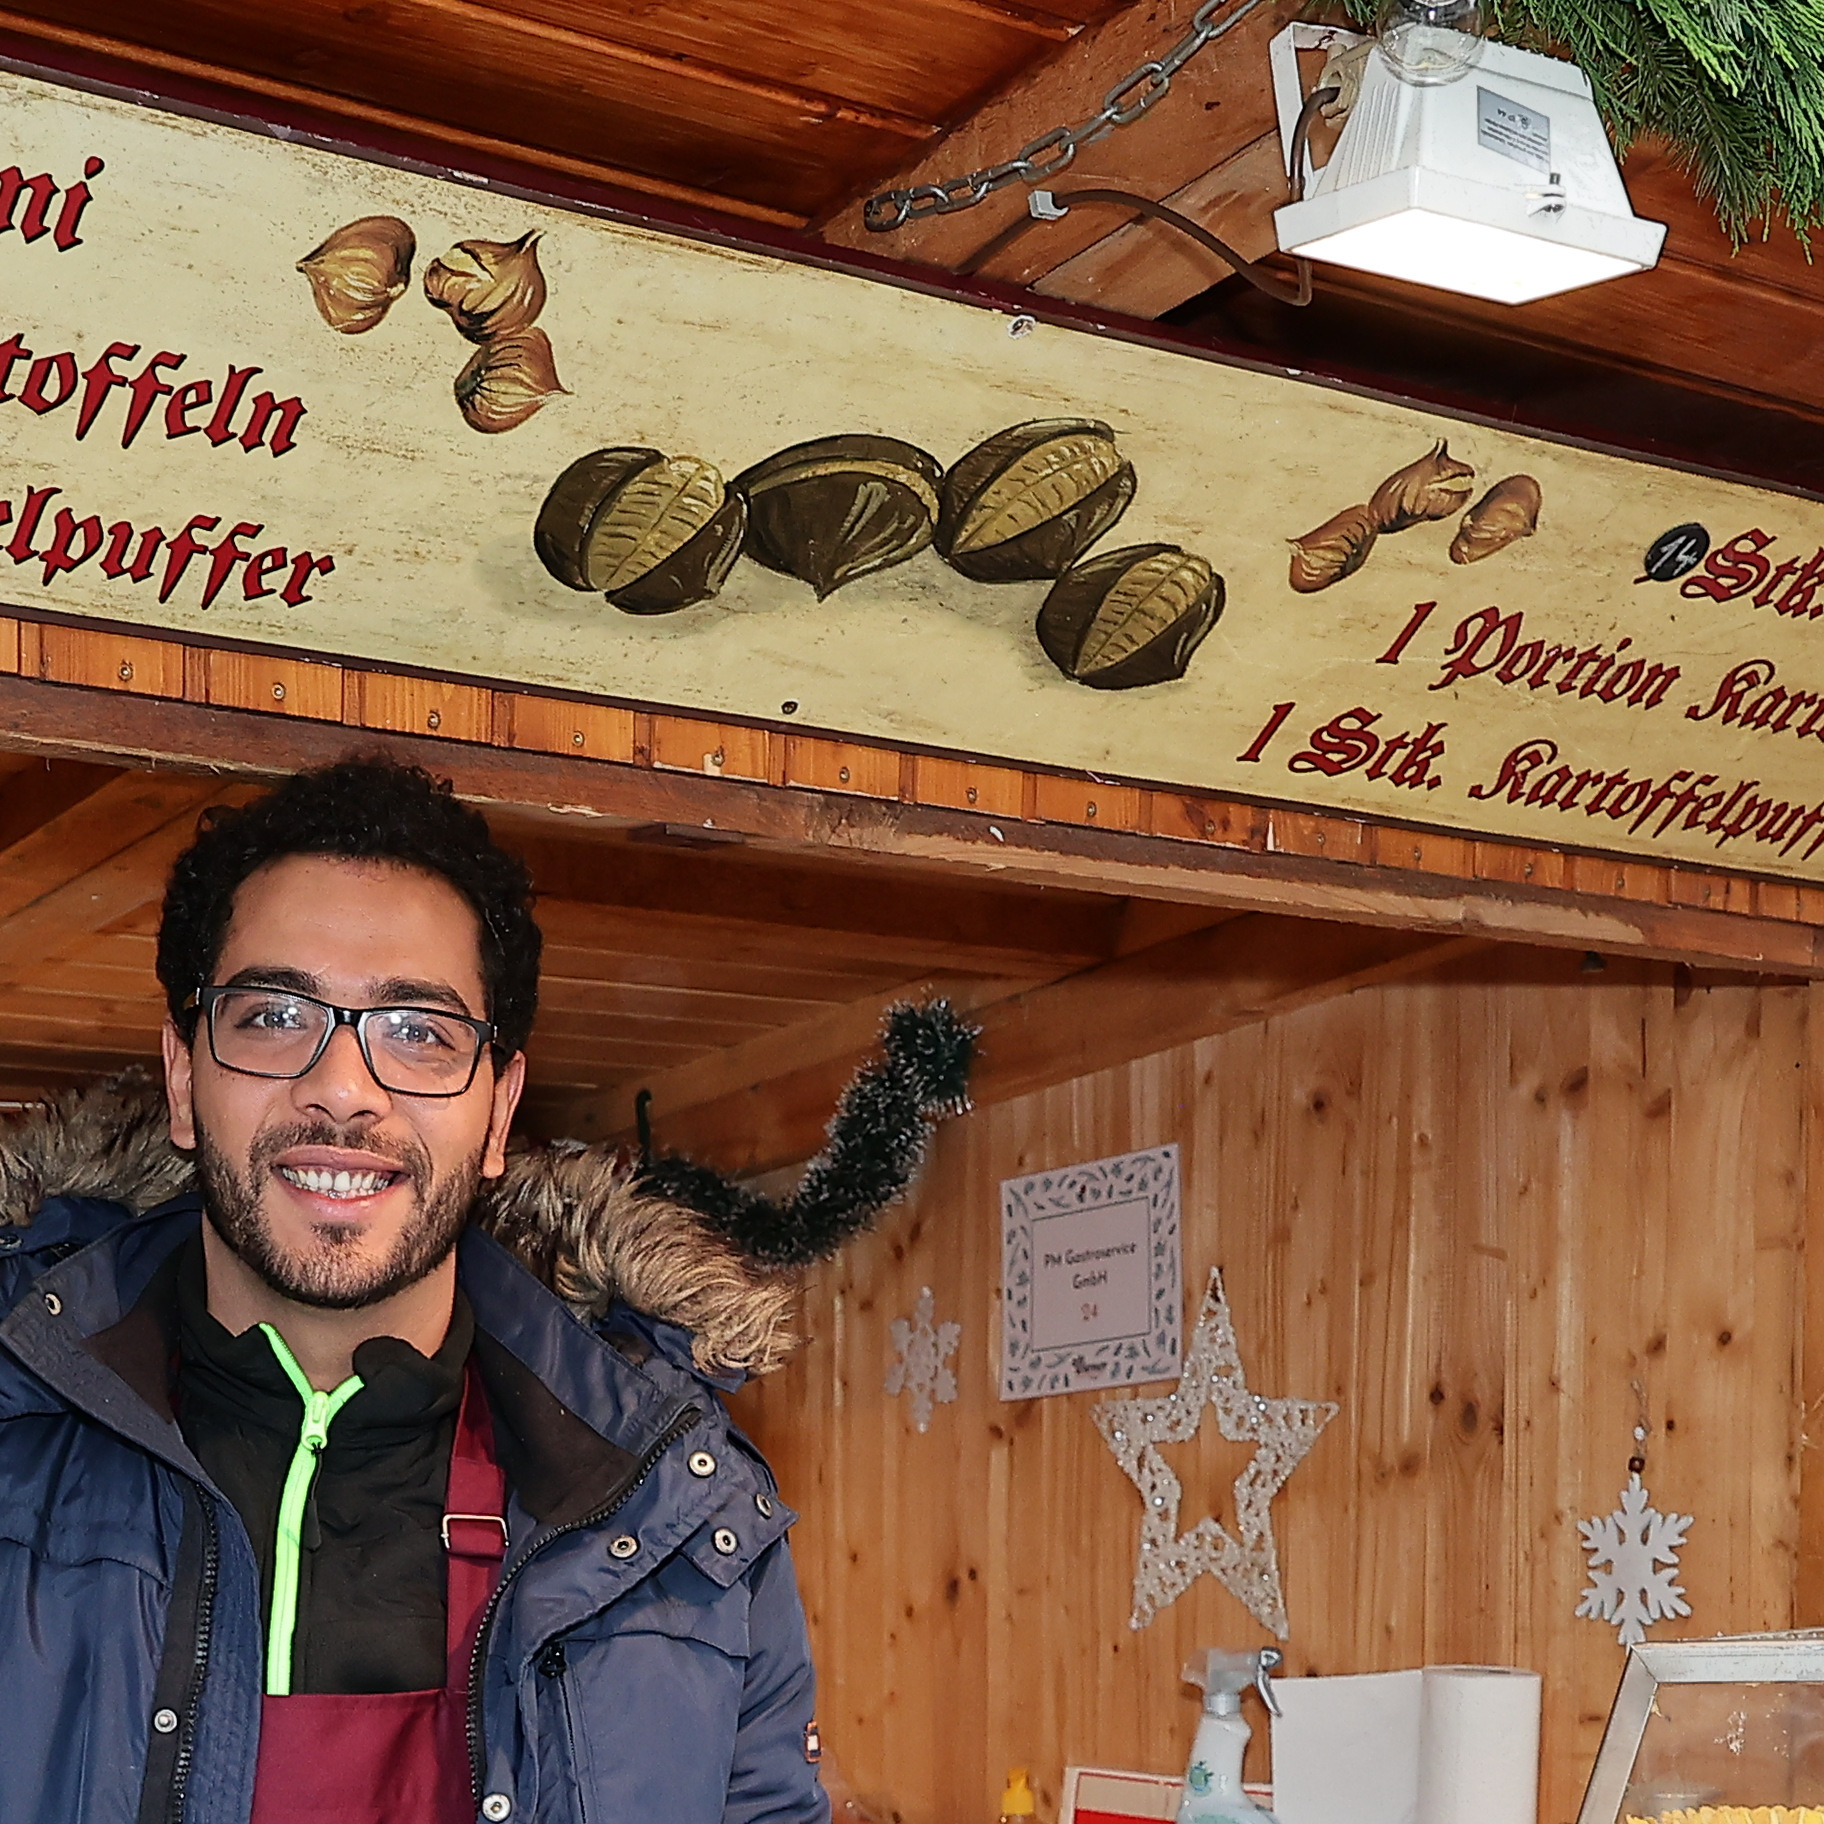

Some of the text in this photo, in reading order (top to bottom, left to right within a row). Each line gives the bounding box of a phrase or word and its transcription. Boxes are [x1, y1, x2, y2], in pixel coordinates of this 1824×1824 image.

[1375, 600, 1437, 668] 1
[1433, 602, 1681, 713] Portion
[1236, 700, 1298, 765] 1
[1286, 703, 1450, 793] Stk.
